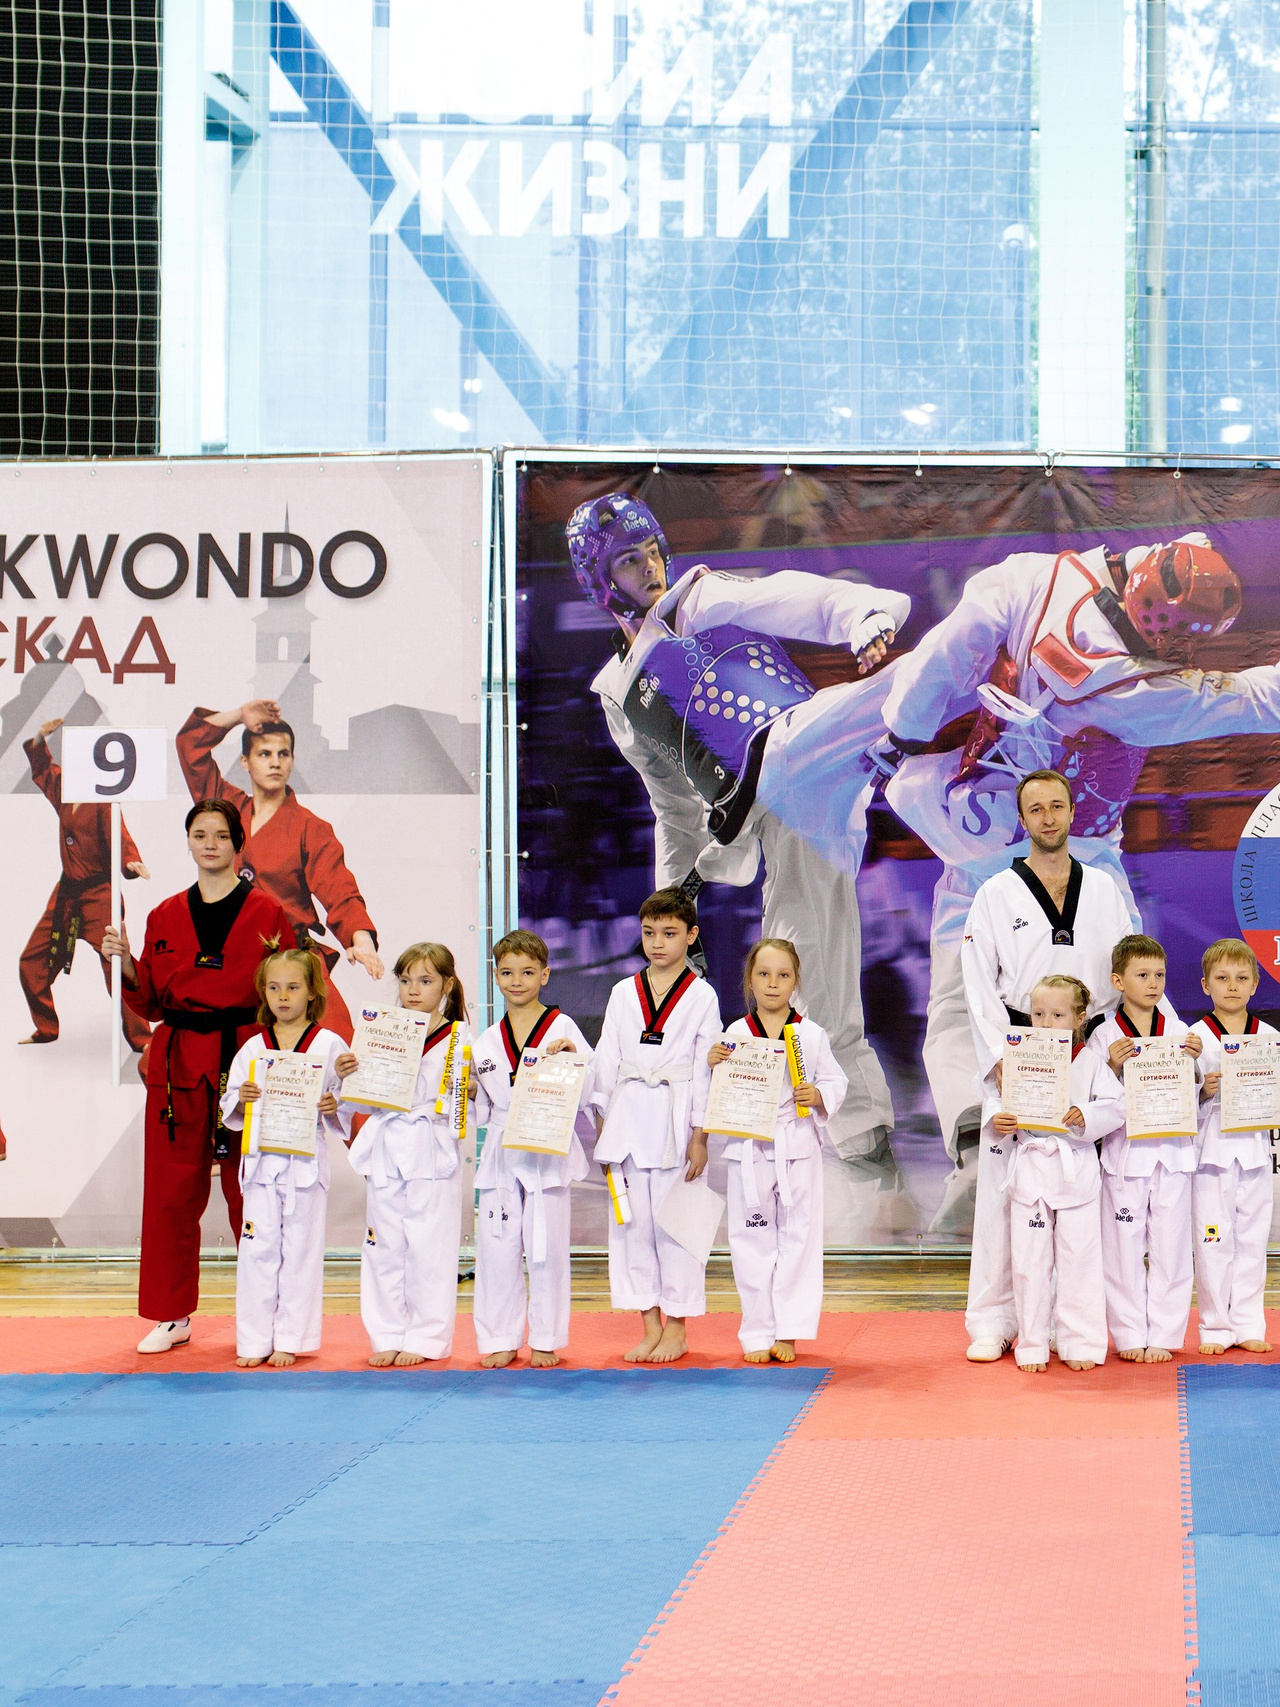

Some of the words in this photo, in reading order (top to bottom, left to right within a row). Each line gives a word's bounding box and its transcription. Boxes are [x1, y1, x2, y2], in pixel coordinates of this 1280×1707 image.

[369, 139, 790, 238] ЖИЗНИ
[0, 616, 176, 684] КАД
[93, 732, 137, 796] 9
[1239, 849, 1259, 924] ШКОЛА
[367, 1041, 407, 1054] СЕРТИФИКАТ
[1017, 1065, 1055, 1074] СЕРТИФИКАТ
[1236, 1070, 1274, 1078] СЕРТИФИКАТ
[728, 1072, 768, 1083] СЕРТИФИКАТ
[1139, 1074, 1179, 1082] СЕРТИФИКАТ
[266, 1088, 305, 1098] СЕРТИФИКАТ
[527, 1086, 566, 1097] СЕРТИФИКАТ
[745, 1219, 768, 1228] Daedo
